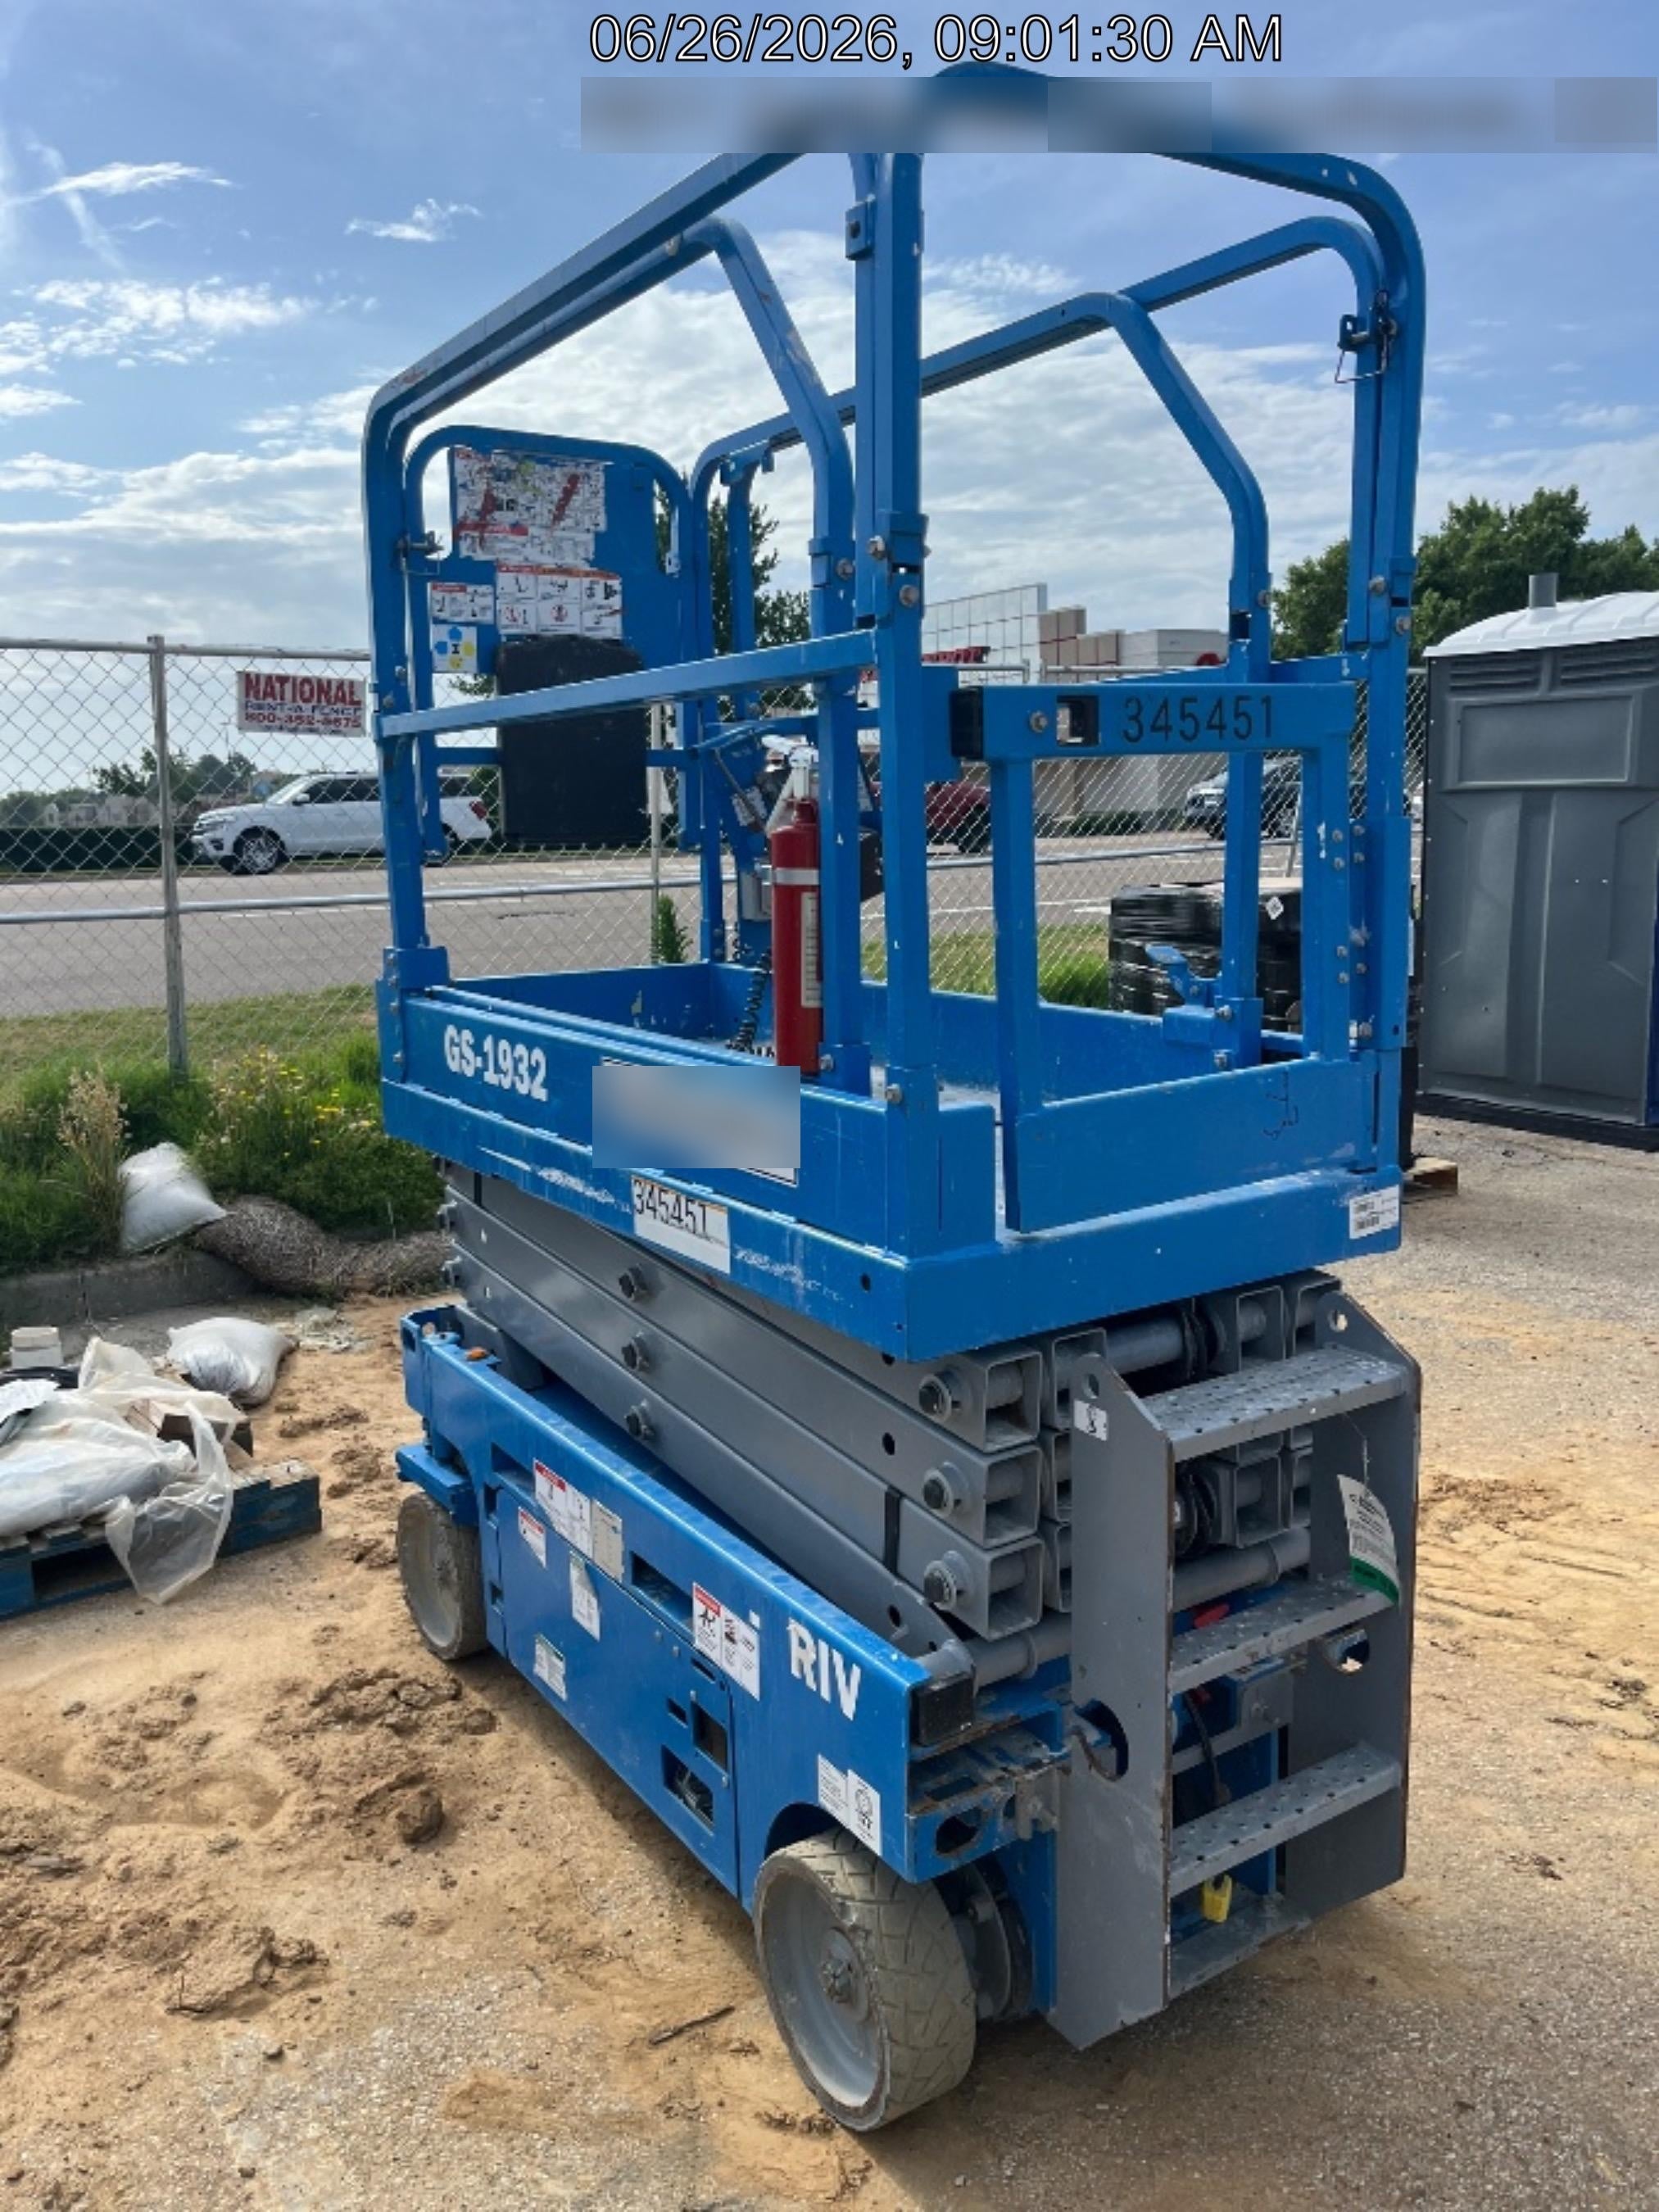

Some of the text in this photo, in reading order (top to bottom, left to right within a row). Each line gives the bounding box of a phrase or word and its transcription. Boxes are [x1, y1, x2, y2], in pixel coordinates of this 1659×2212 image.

[244, 672, 362, 707] NATIONAL
[1122, 696, 1273, 743] 345451
[443, 1024, 548, 1103] GS-1932
[633, 1178, 709, 1236] 345451
[786, 1616, 861, 1721] RIV
